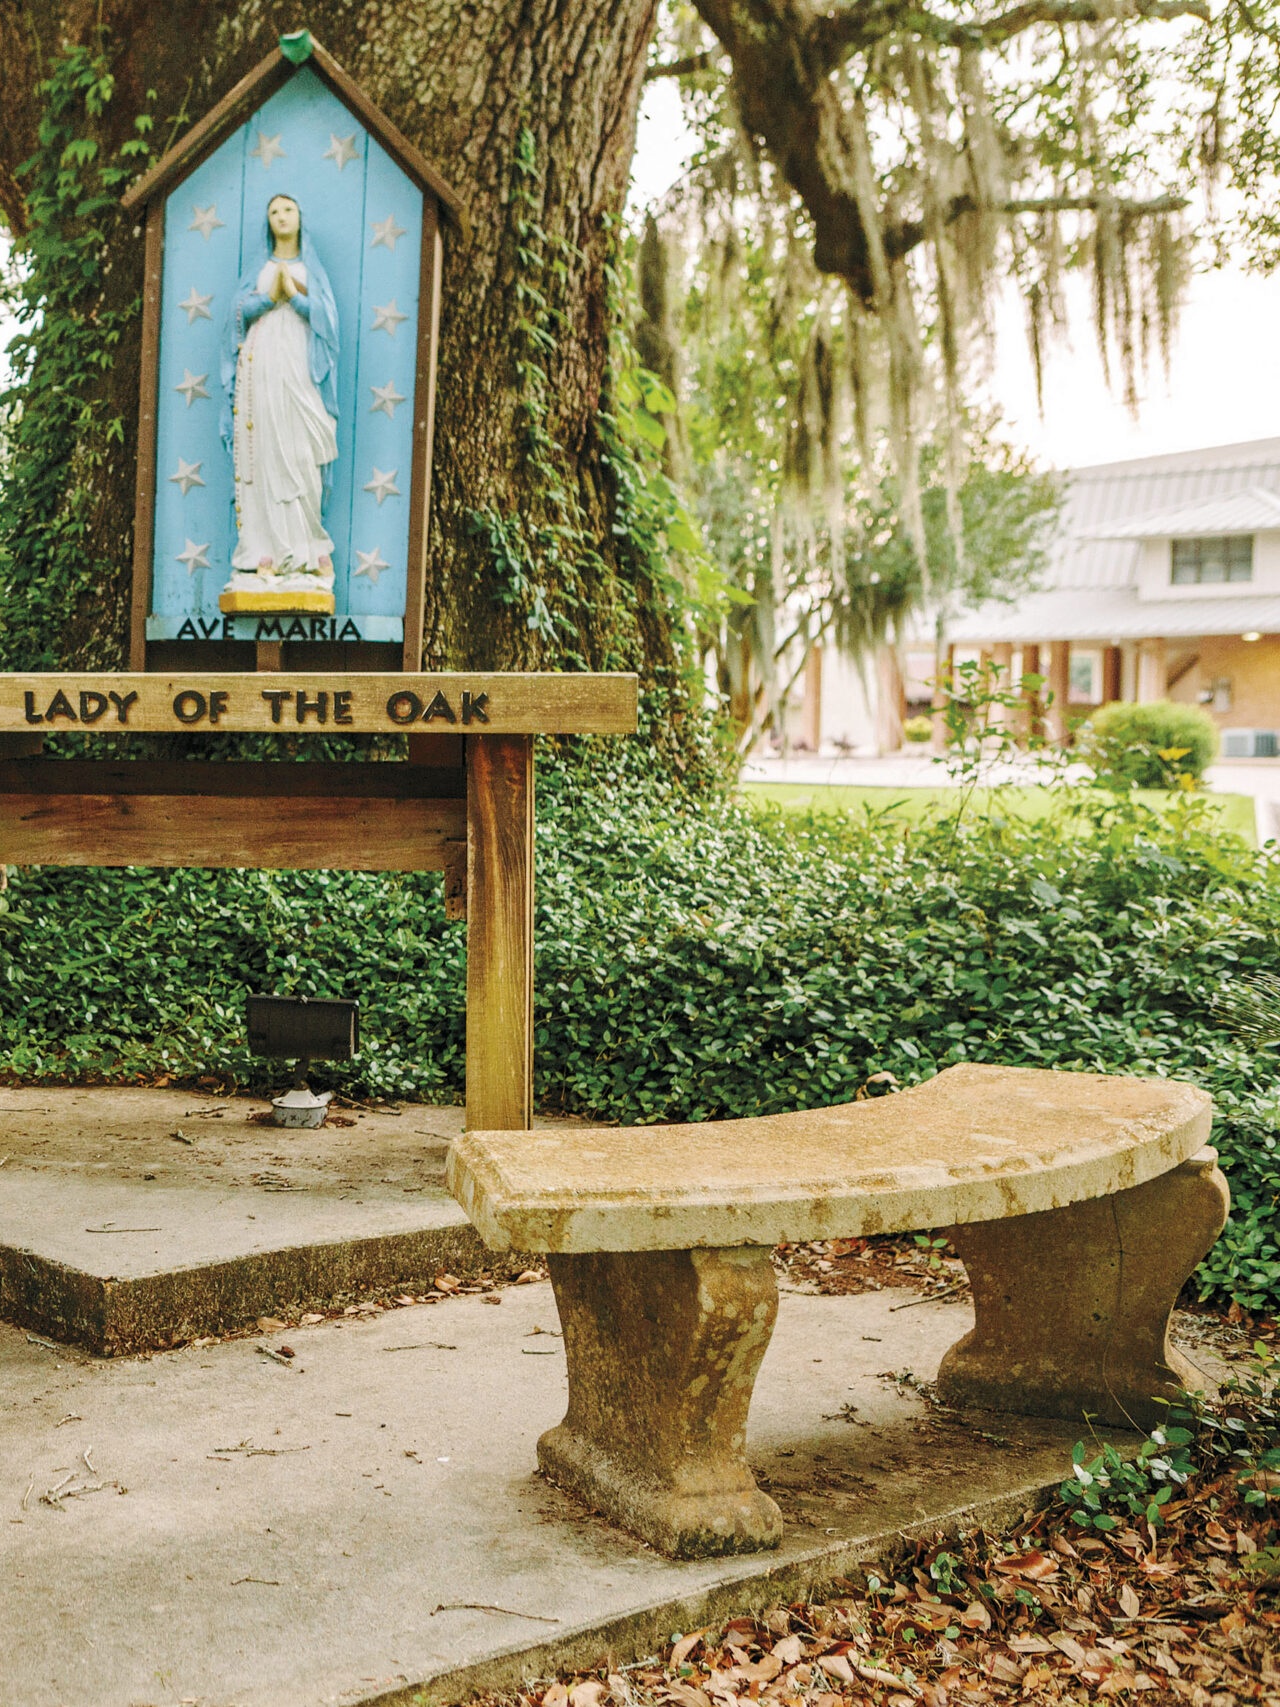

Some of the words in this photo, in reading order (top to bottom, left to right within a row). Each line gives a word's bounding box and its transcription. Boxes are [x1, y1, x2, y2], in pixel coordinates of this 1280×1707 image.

[176, 617, 235, 639] AVE
[255, 617, 362, 640] MARIA
[24, 689, 138, 723] LADY
[173, 690, 229, 723] OF
[261, 689, 353, 724] THE
[386, 689, 490, 724] OAK
